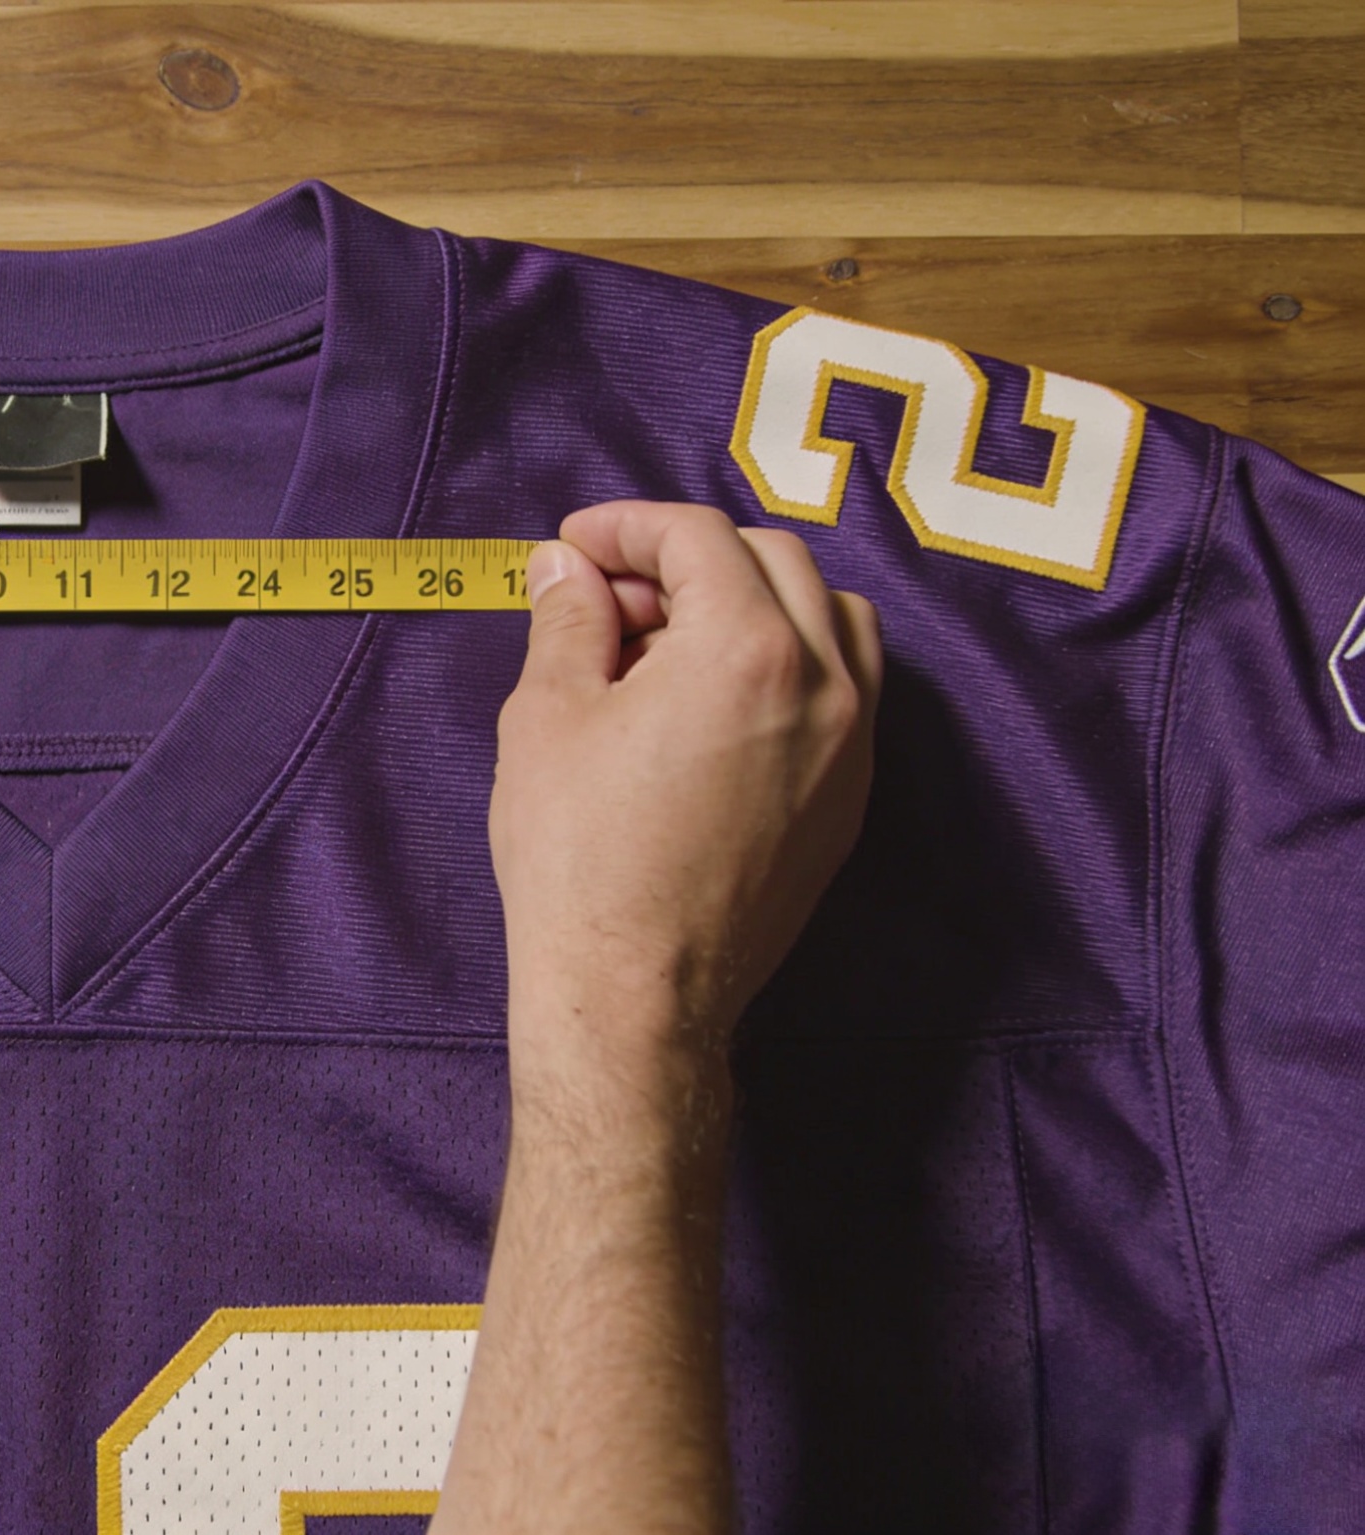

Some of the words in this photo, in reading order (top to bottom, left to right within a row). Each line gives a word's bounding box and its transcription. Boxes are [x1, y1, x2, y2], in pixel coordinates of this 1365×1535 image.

[54, 570, 94, 599] 11
[145, 570, 191, 598] 12
[236, 569, 282, 597] 24
[328, 569, 374, 597] 25
[417, 568, 464, 597] 26
